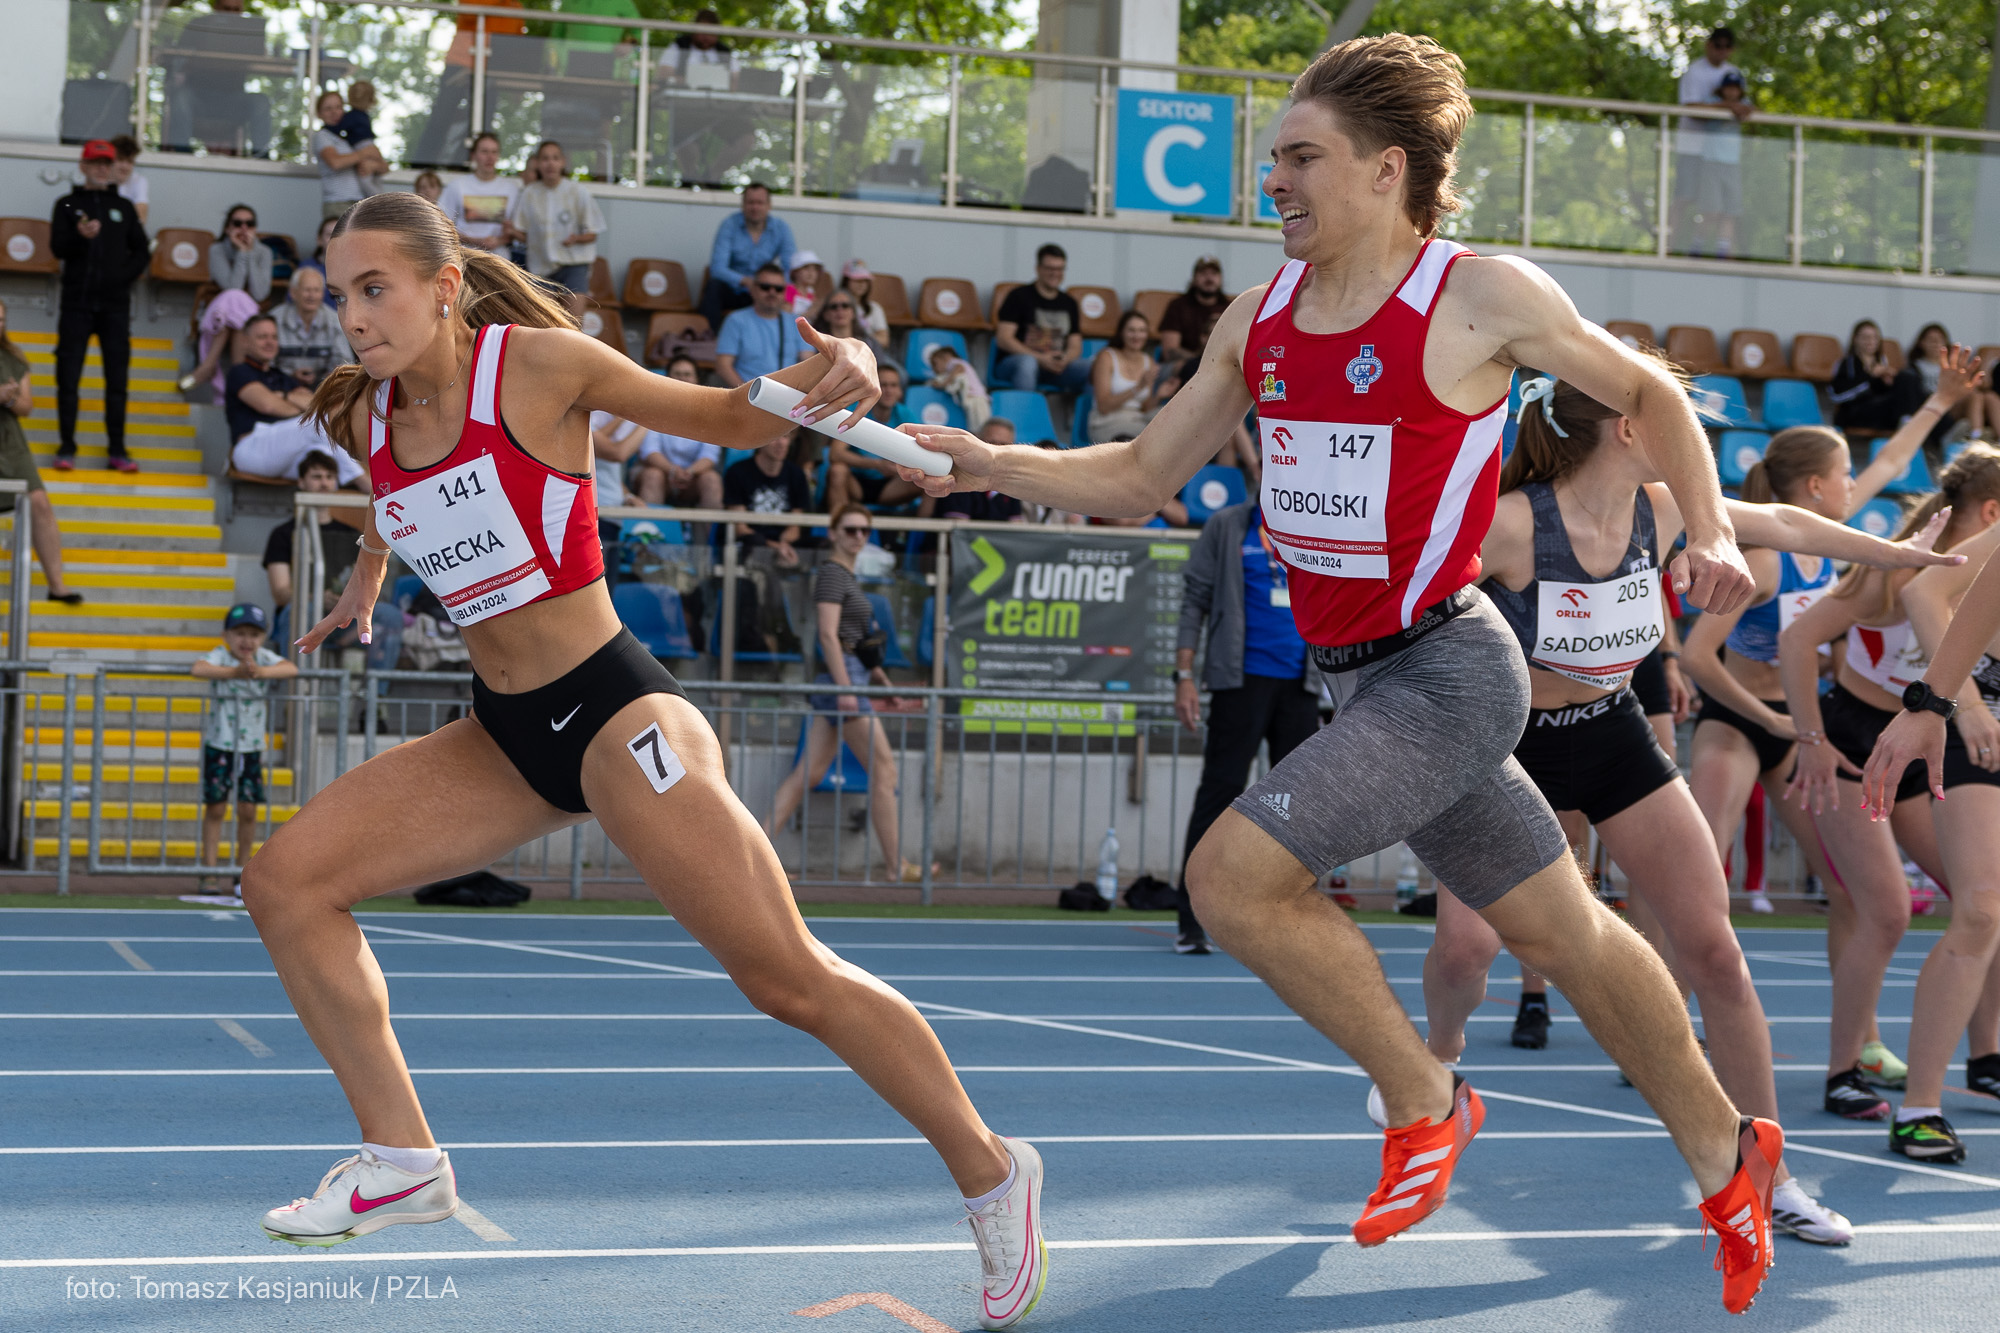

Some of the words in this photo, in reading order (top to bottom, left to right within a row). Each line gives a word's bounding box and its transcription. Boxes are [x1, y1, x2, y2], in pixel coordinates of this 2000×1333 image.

[1137, 98, 1213, 122] SEKTOR
[1142, 124, 1207, 206] C
[1262, 363, 1276, 372] BKS
[1328, 433, 1375, 459] 147
[1271, 454, 1297, 466] ORLEN
[438, 470, 486, 508] 141
[1271, 488, 1368, 518] TOBOLSKI
[391, 523, 418, 541] ORLEN
[412, 529, 505, 578] MIRECKA
[1067, 549, 1130, 565] PERFECT
[1294, 551, 1319, 567] LUBLIN
[1320, 555, 1342, 569] 2024
[1346, 544, 1383, 552] MIESZANYCH
[1012, 562, 1134, 602] runner
[1617, 579, 1649, 604] 205
[451, 591, 468, 603] POLSKI
[482, 592, 507, 610] 2024
[984, 599, 1081, 638] team
[1404, 614, 1444, 639] adidas
[1556, 610, 1591, 619] ORLEN
[1541, 624, 1661, 653] SADOWSKA
[1567, 673, 1604, 685] LUBLIN
[1536, 695, 1612, 727] NIKE
[632, 728, 668, 780] 7
[1259, 795, 1290, 820] adidas
